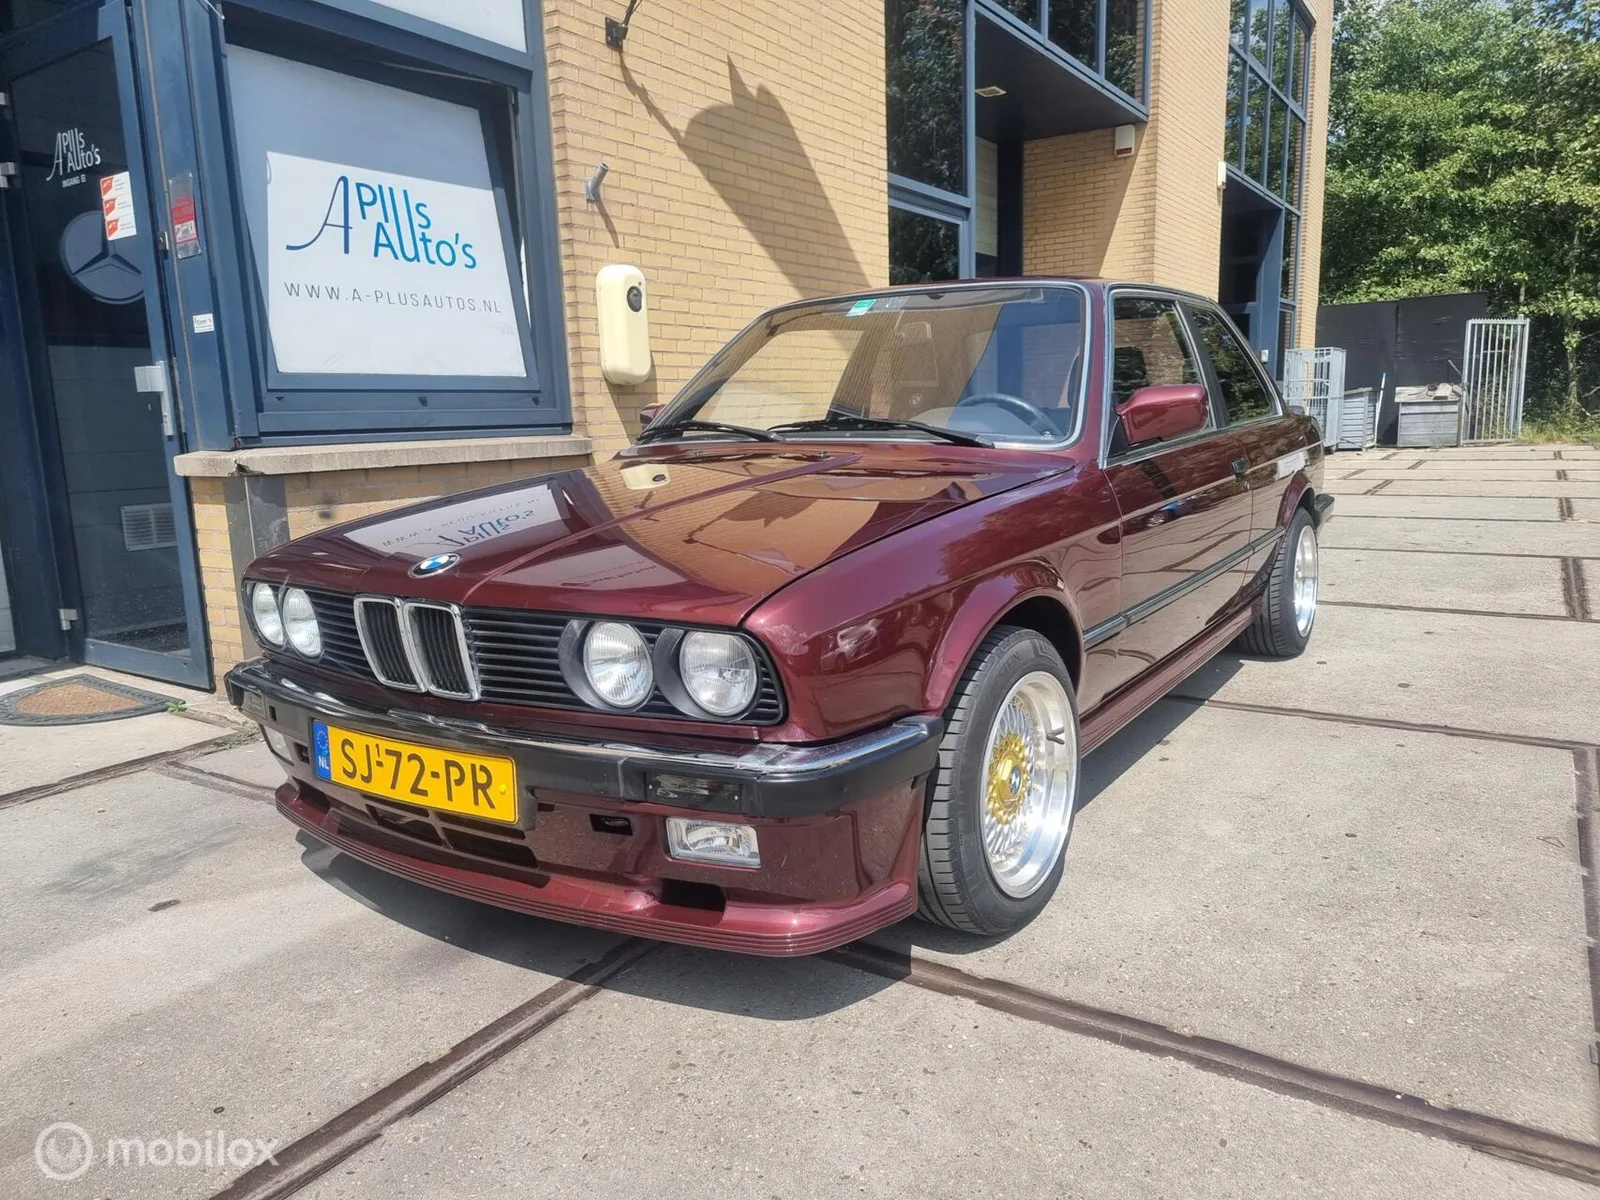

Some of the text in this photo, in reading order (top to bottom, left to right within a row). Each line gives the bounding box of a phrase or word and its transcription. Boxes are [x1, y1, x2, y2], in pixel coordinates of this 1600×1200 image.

[284, 281, 501, 314] WWW.A-PLUSAUTOS.NL
[318, 755, 330, 771] NL
[340, 738, 496, 809] SJ-72-PR
